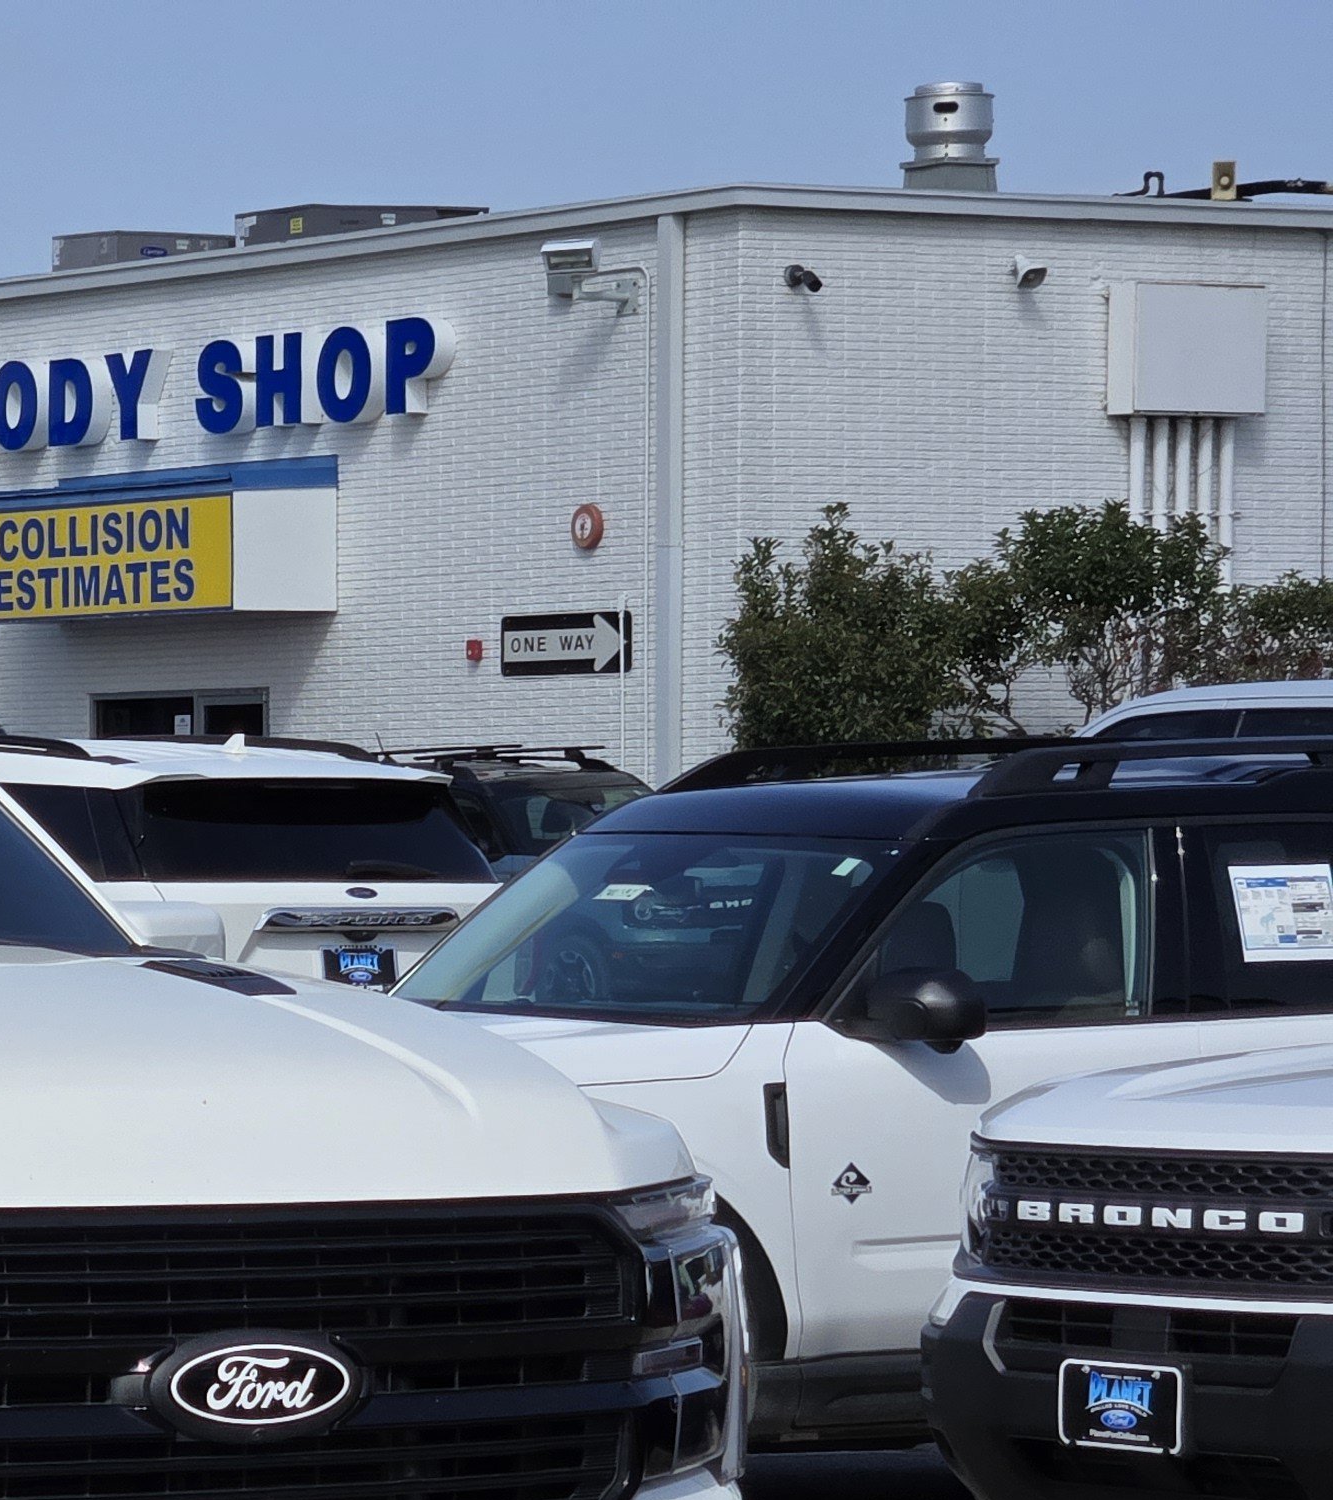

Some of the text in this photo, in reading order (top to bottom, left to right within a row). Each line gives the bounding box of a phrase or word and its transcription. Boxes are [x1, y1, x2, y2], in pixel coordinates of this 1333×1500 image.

[195, 317, 436, 434] SHOP
[510, 634, 595, 653] ONE WAY
[340, 951, 379, 971] PLANET
[1017, 1200, 1304, 1233] BRONCO
[206, 1355, 317, 1410] Ford
[1088, 1370, 1153, 1413] PLANET
